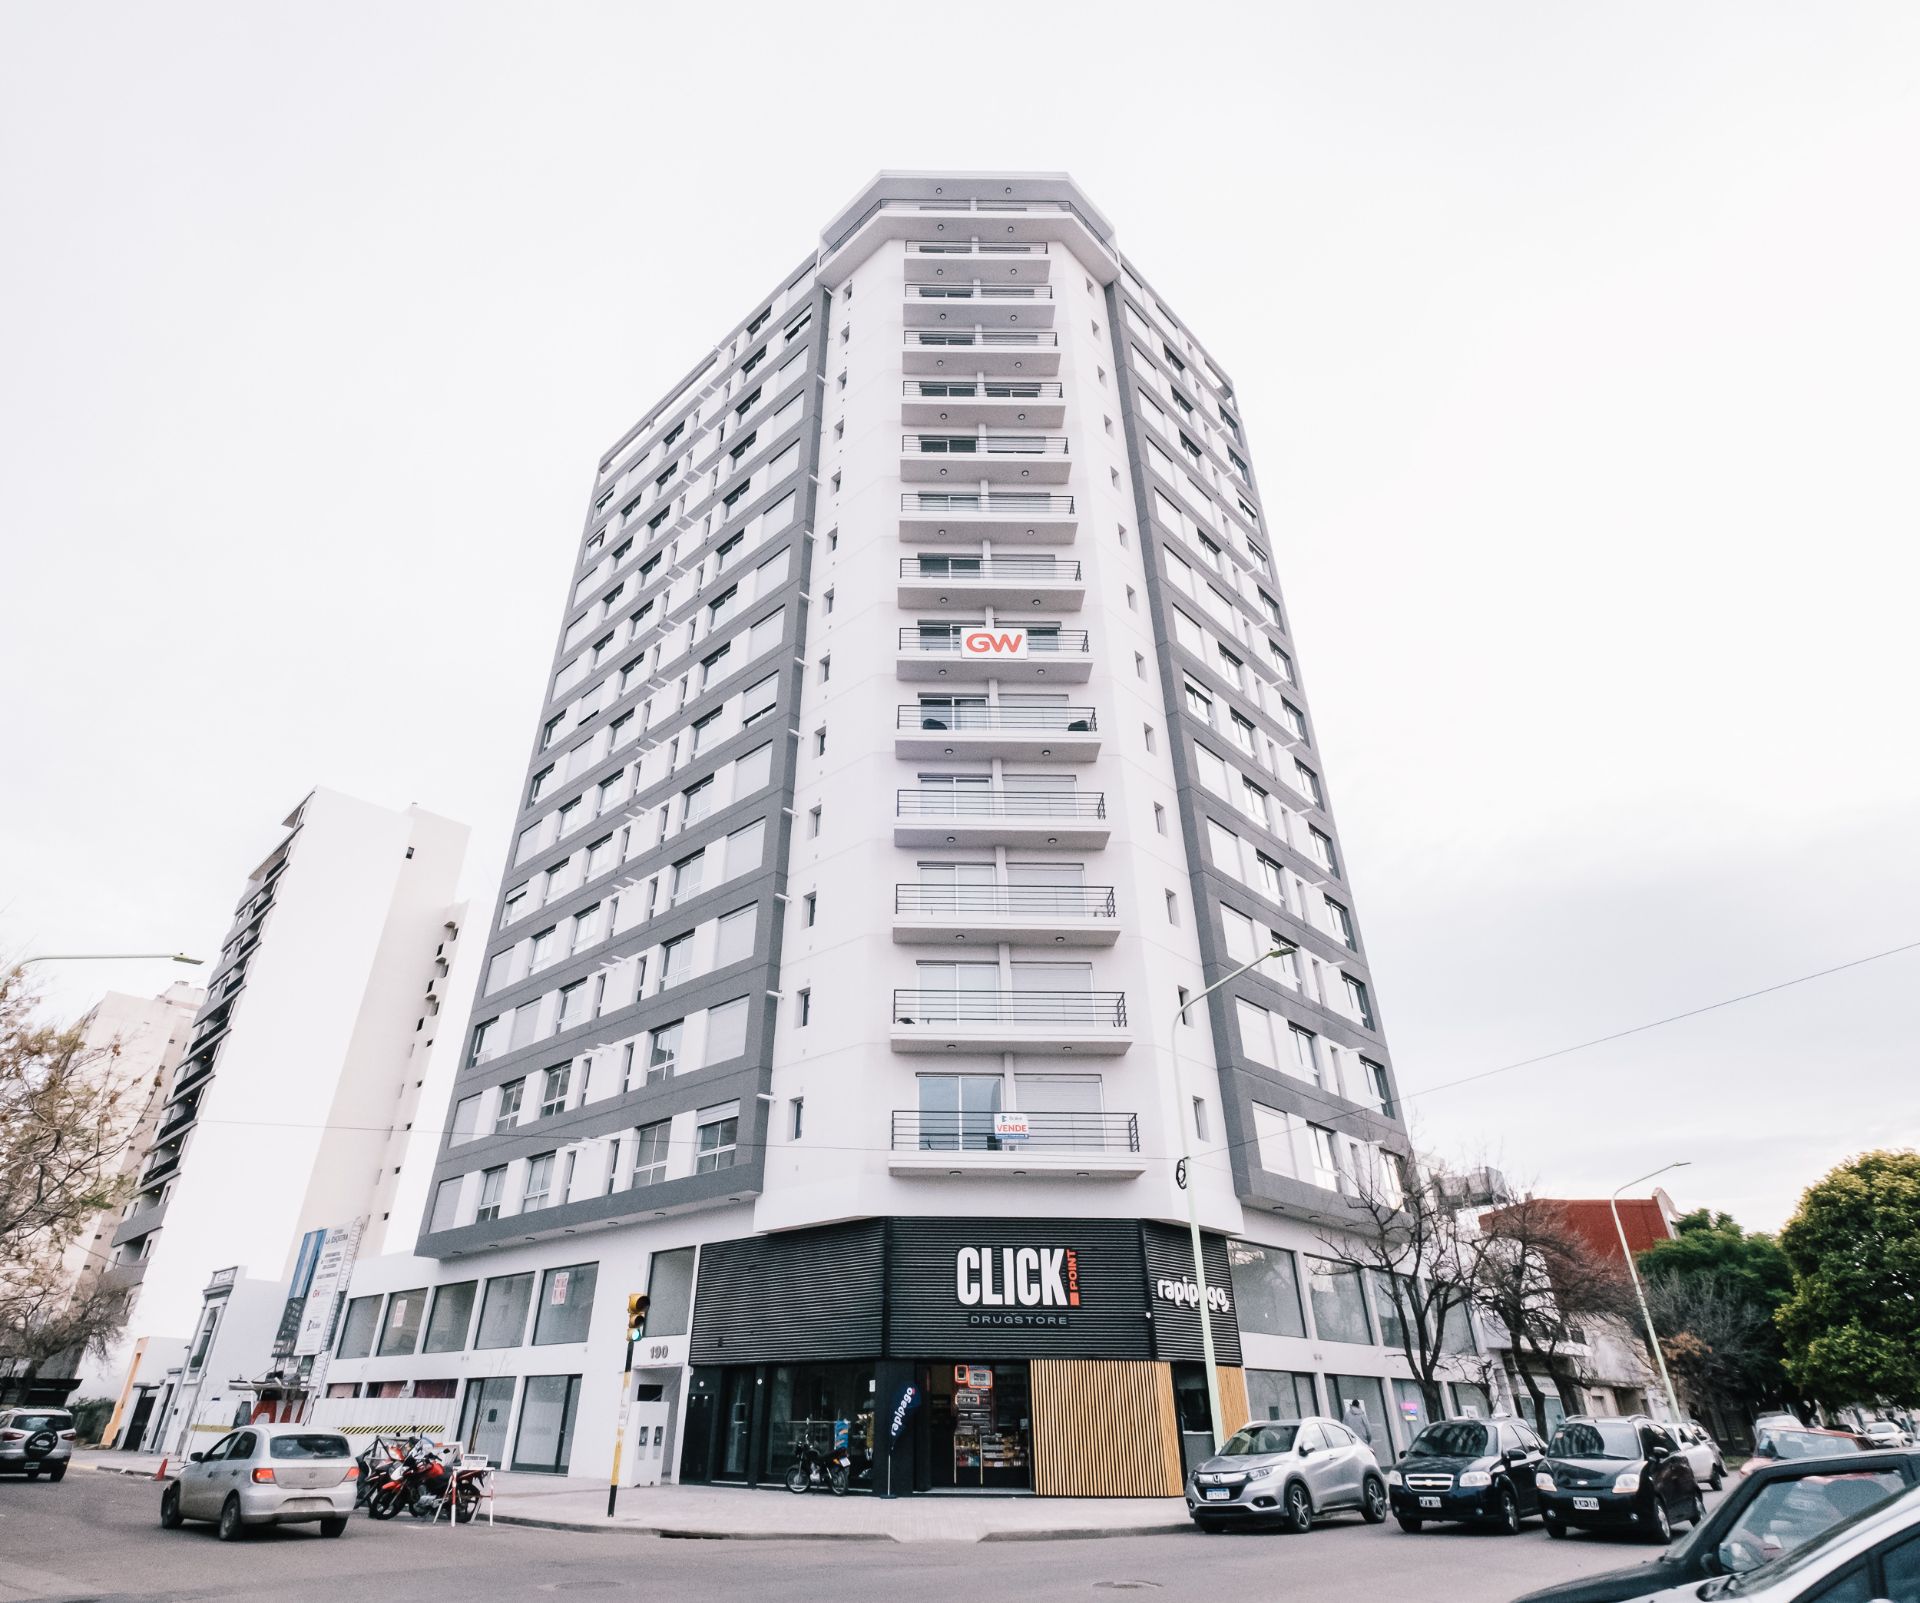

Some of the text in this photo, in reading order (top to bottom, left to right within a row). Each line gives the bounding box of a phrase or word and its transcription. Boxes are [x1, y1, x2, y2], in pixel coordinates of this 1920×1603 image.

[966, 633, 1022, 653] GW
[997, 1124, 1027, 1132] VENDE
[957, 1247, 1068, 1306] CLICK
[1066, 1249, 1079, 1290] POINT
[1157, 1276, 1230, 1312] rapipgo
[970, 1315, 1068, 1325] DRUGSTORE
[650, 1345, 669, 1359] 190
[891, 1386, 914, 1436] rapipago
